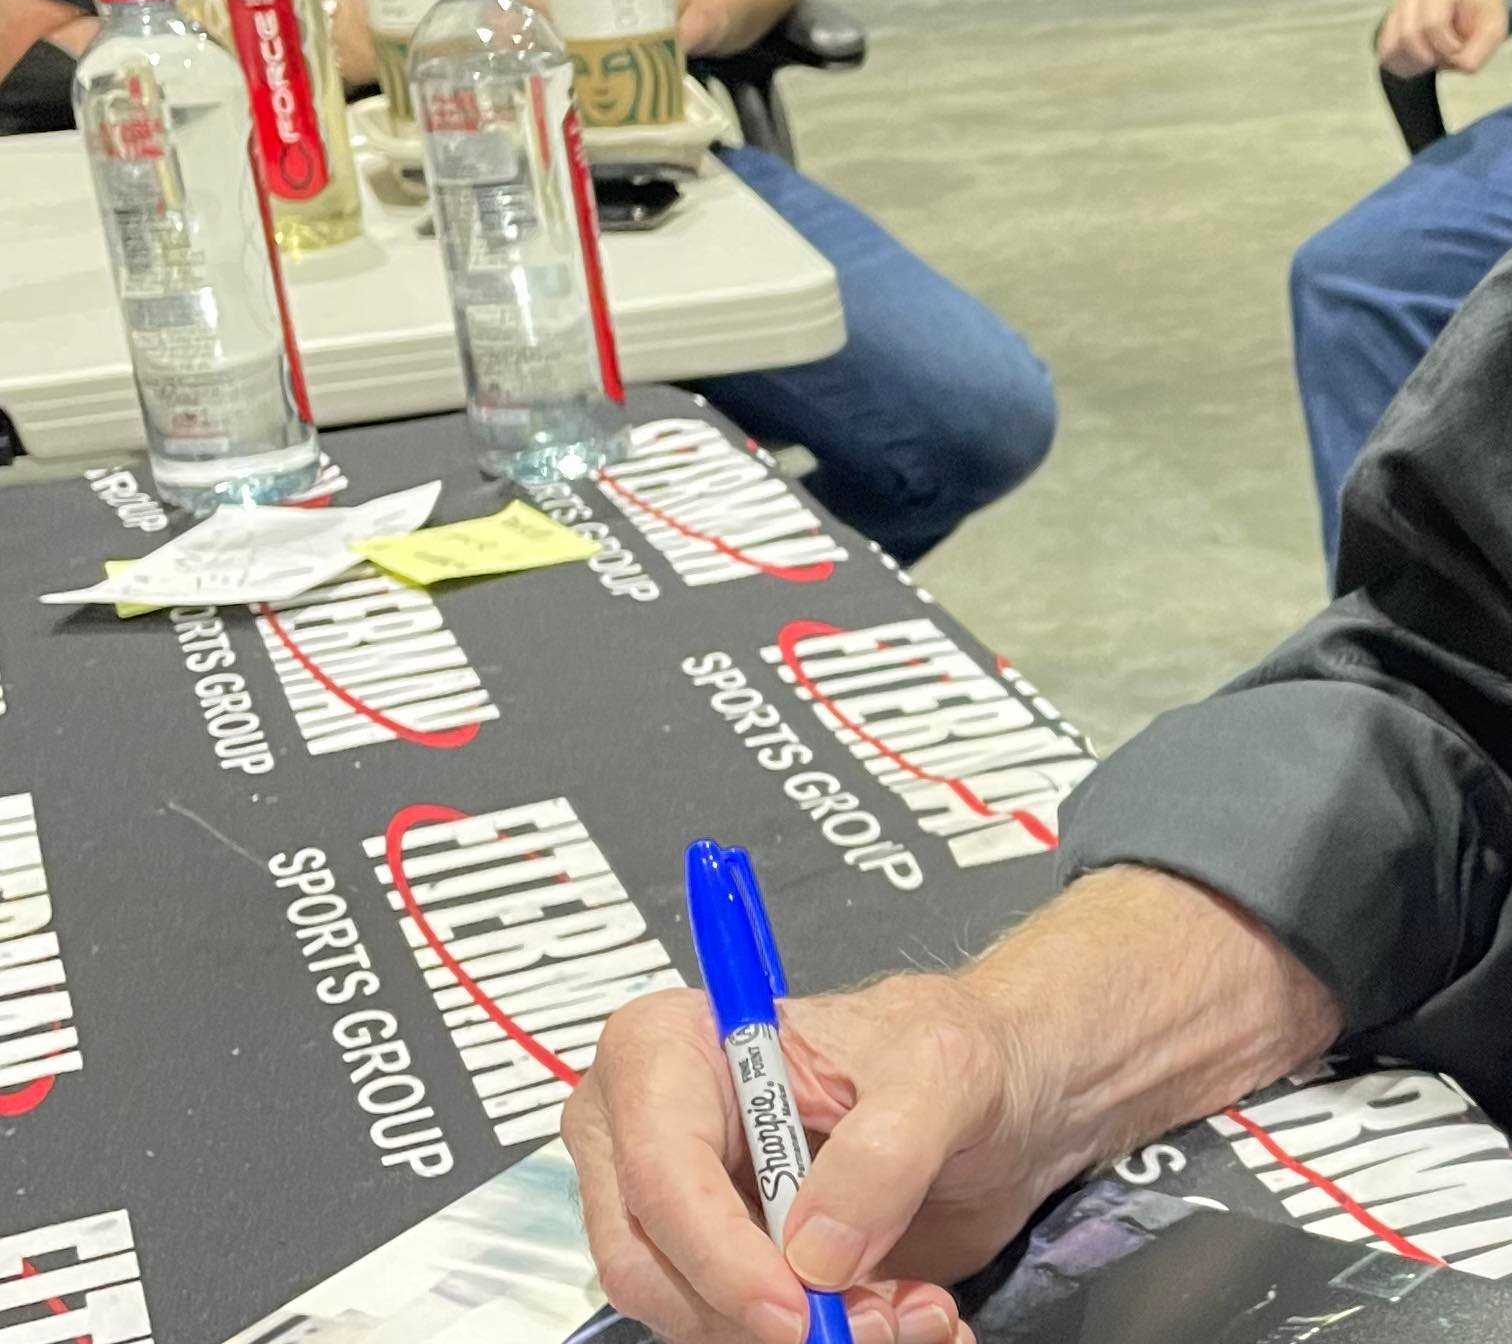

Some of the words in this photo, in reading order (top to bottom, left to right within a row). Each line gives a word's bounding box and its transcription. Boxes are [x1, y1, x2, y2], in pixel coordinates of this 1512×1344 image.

[253, 8, 302, 144] FORCE
[194, 671, 275, 775] GROUP
[680, 649, 814, 772] SPORTS
[267, 846, 381, 1006] SPORTS
[331, 1008, 455, 1179] GROUP
[746, 1087, 801, 1203] Sharpie
